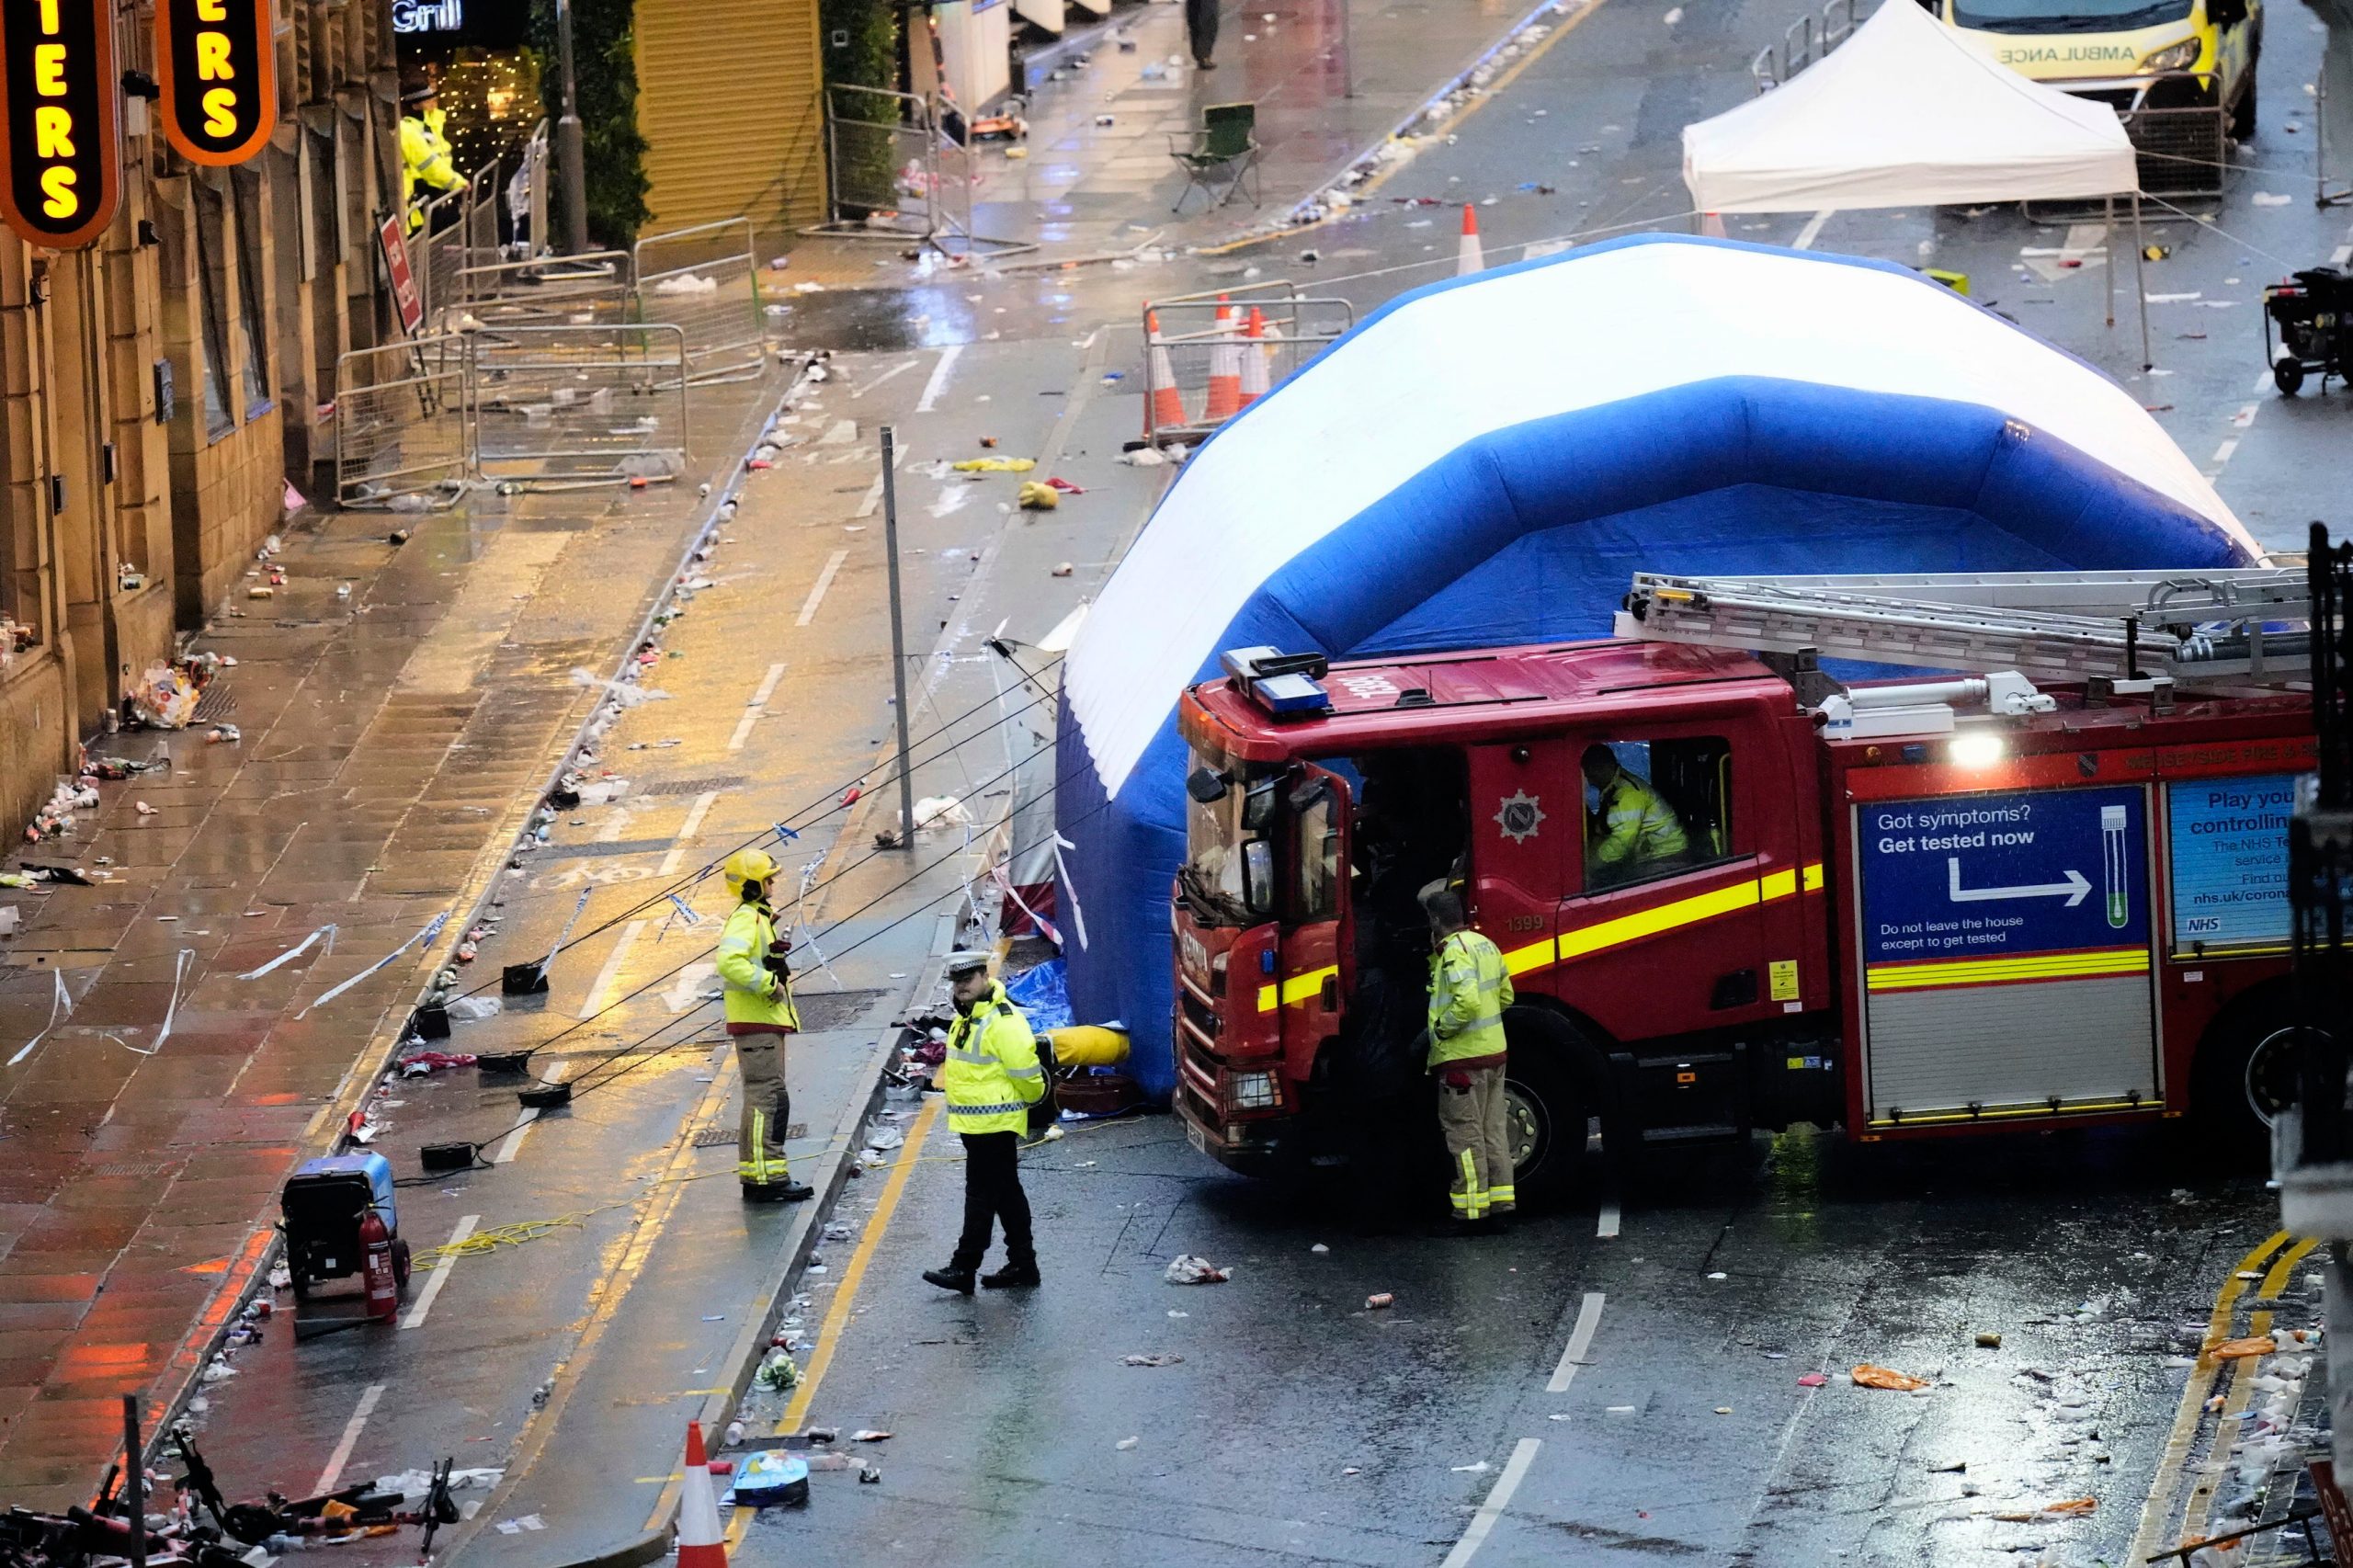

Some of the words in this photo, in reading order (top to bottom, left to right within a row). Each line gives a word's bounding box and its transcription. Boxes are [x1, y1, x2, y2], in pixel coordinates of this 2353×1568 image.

[392, 0, 461, 32] Grill
[2208, 791, 2252, 810] Play
[2257, 791, 2294, 809] you
[1878, 813, 1914, 830] Got
[1919, 804, 2031, 830] symptoms?
[2190, 813, 2287, 835] controllin
[1879, 837, 1915, 854] Get
[1920, 832, 1985, 851] tested
[1992, 832, 2034, 846] now
[2212, 840, 2239, 853] The
[2241, 837, 2271, 851] NHS
[2275, 836, 2291, 847] Te
[2234, 854, 2281, 867] service
[2242, 872, 2270, 885] Find
[2274, 873, 2290, 883] ou
[2194, 888, 2291, 904] nhs.uk/corona
[1506, 915, 1544, 932] 1399
[1881, 925, 1899, 936] Do
[1902, 922, 1922, 933] not
[1926, 921, 1959, 932] leave
[1962, 919, 1983, 929] the
[1985, 916, 2024, 927] house
[2188, 917, 2220, 932] NHS
[1881, 937, 1924, 950] except
[1927, 937, 1940, 947] to
[1943, 936, 1963, 949] get
[1967, 931, 2006, 944] tested
